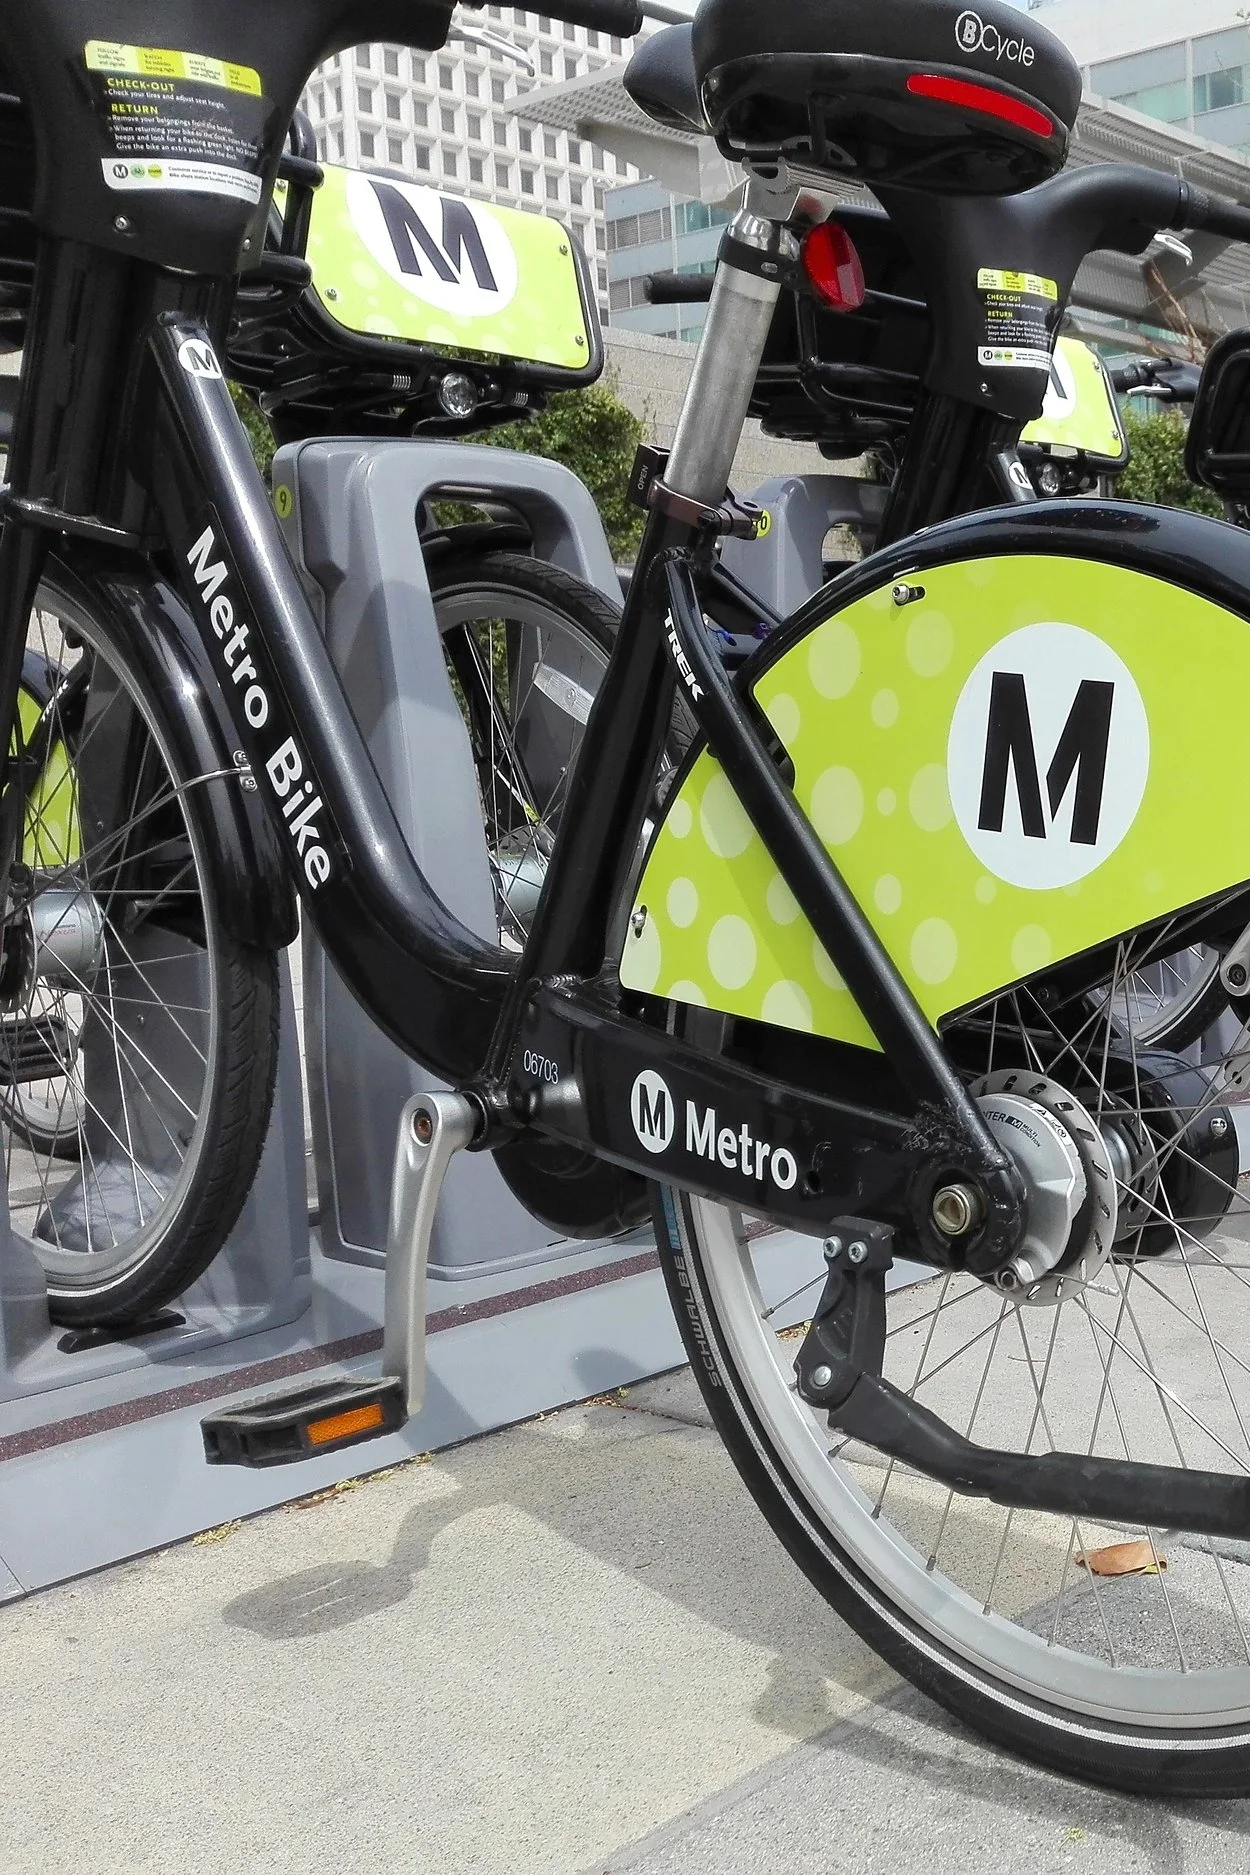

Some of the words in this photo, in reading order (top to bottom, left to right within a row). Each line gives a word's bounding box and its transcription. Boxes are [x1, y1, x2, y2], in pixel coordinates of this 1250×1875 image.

[955, 10, 1035, 67] BCycle
[107, 78, 175, 91] CHECK-OUT
[108, 88, 129, 96] Check
[146, 91, 160, 99] tires
[111, 103, 158, 115] RETURN
[135, 126, 165, 134] returning
[156, 116, 191, 126] belongings
[114, 133, 134, 141] beeps
[188, 146, 203, 154] push
[114, 166, 126, 177] M
[367, 179, 499, 292] M
[185, 347, 220, 374] M
[637, 464, 649, 490] OPEN
[280, 491, 287, 512] 9
[664, 607, 705, 702] TREK
[186, 525, 269, 729] Metro
[265, 736, 331, 890] Bike
[977, 671, 1115, 846] M
[523, 1049, 559, 1085] 06703
[639, 1082, 666, 1142] M
[686, 1099, 798, 1190] Metro
[1023, 1124, 1038, 1137] MULTI
[674, 1255, 722, 1387] SCHWALBE
